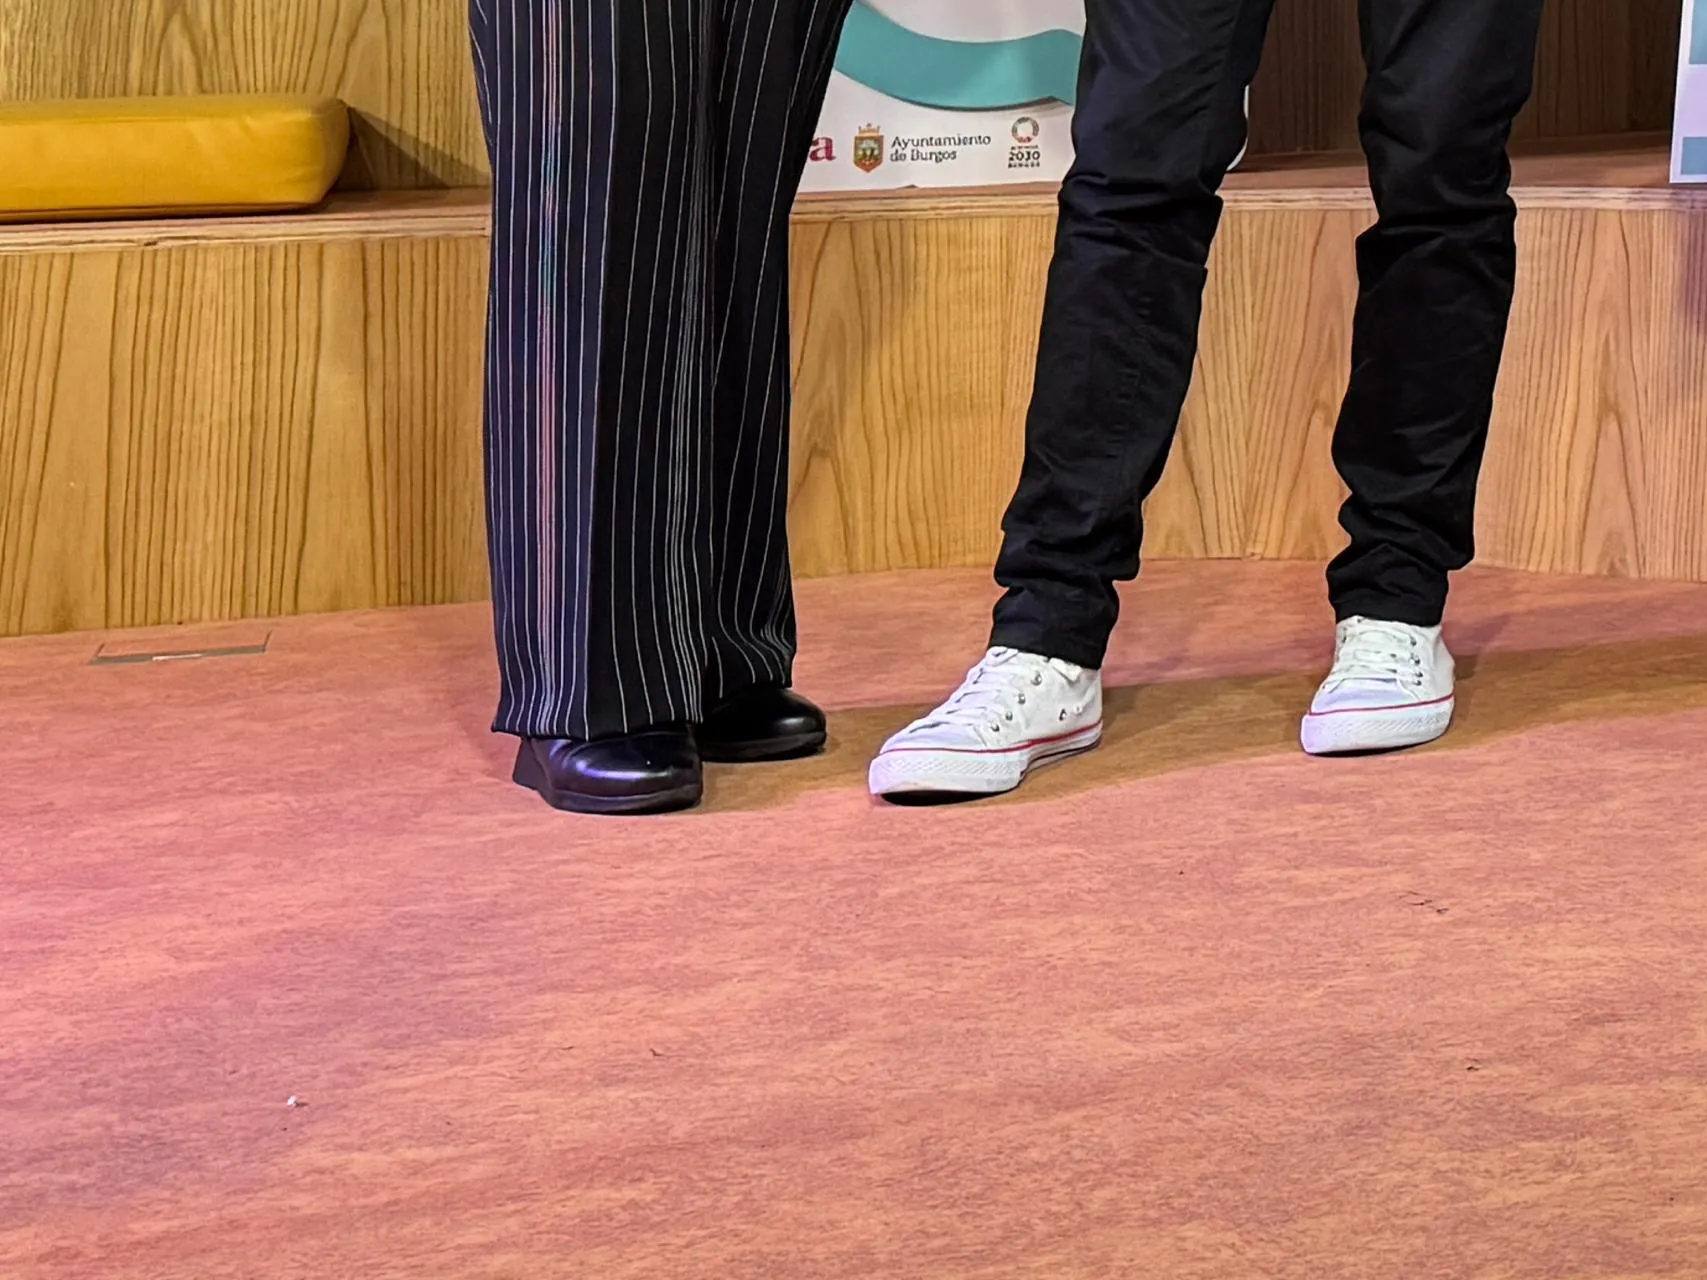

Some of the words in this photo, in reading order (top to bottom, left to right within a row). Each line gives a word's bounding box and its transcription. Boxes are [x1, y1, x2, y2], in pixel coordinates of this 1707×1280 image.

[891, 133, 991, 150] Ayuntamiento
[890, 150, 906, 162] de
[911, 150, 957, 163] Burgos
